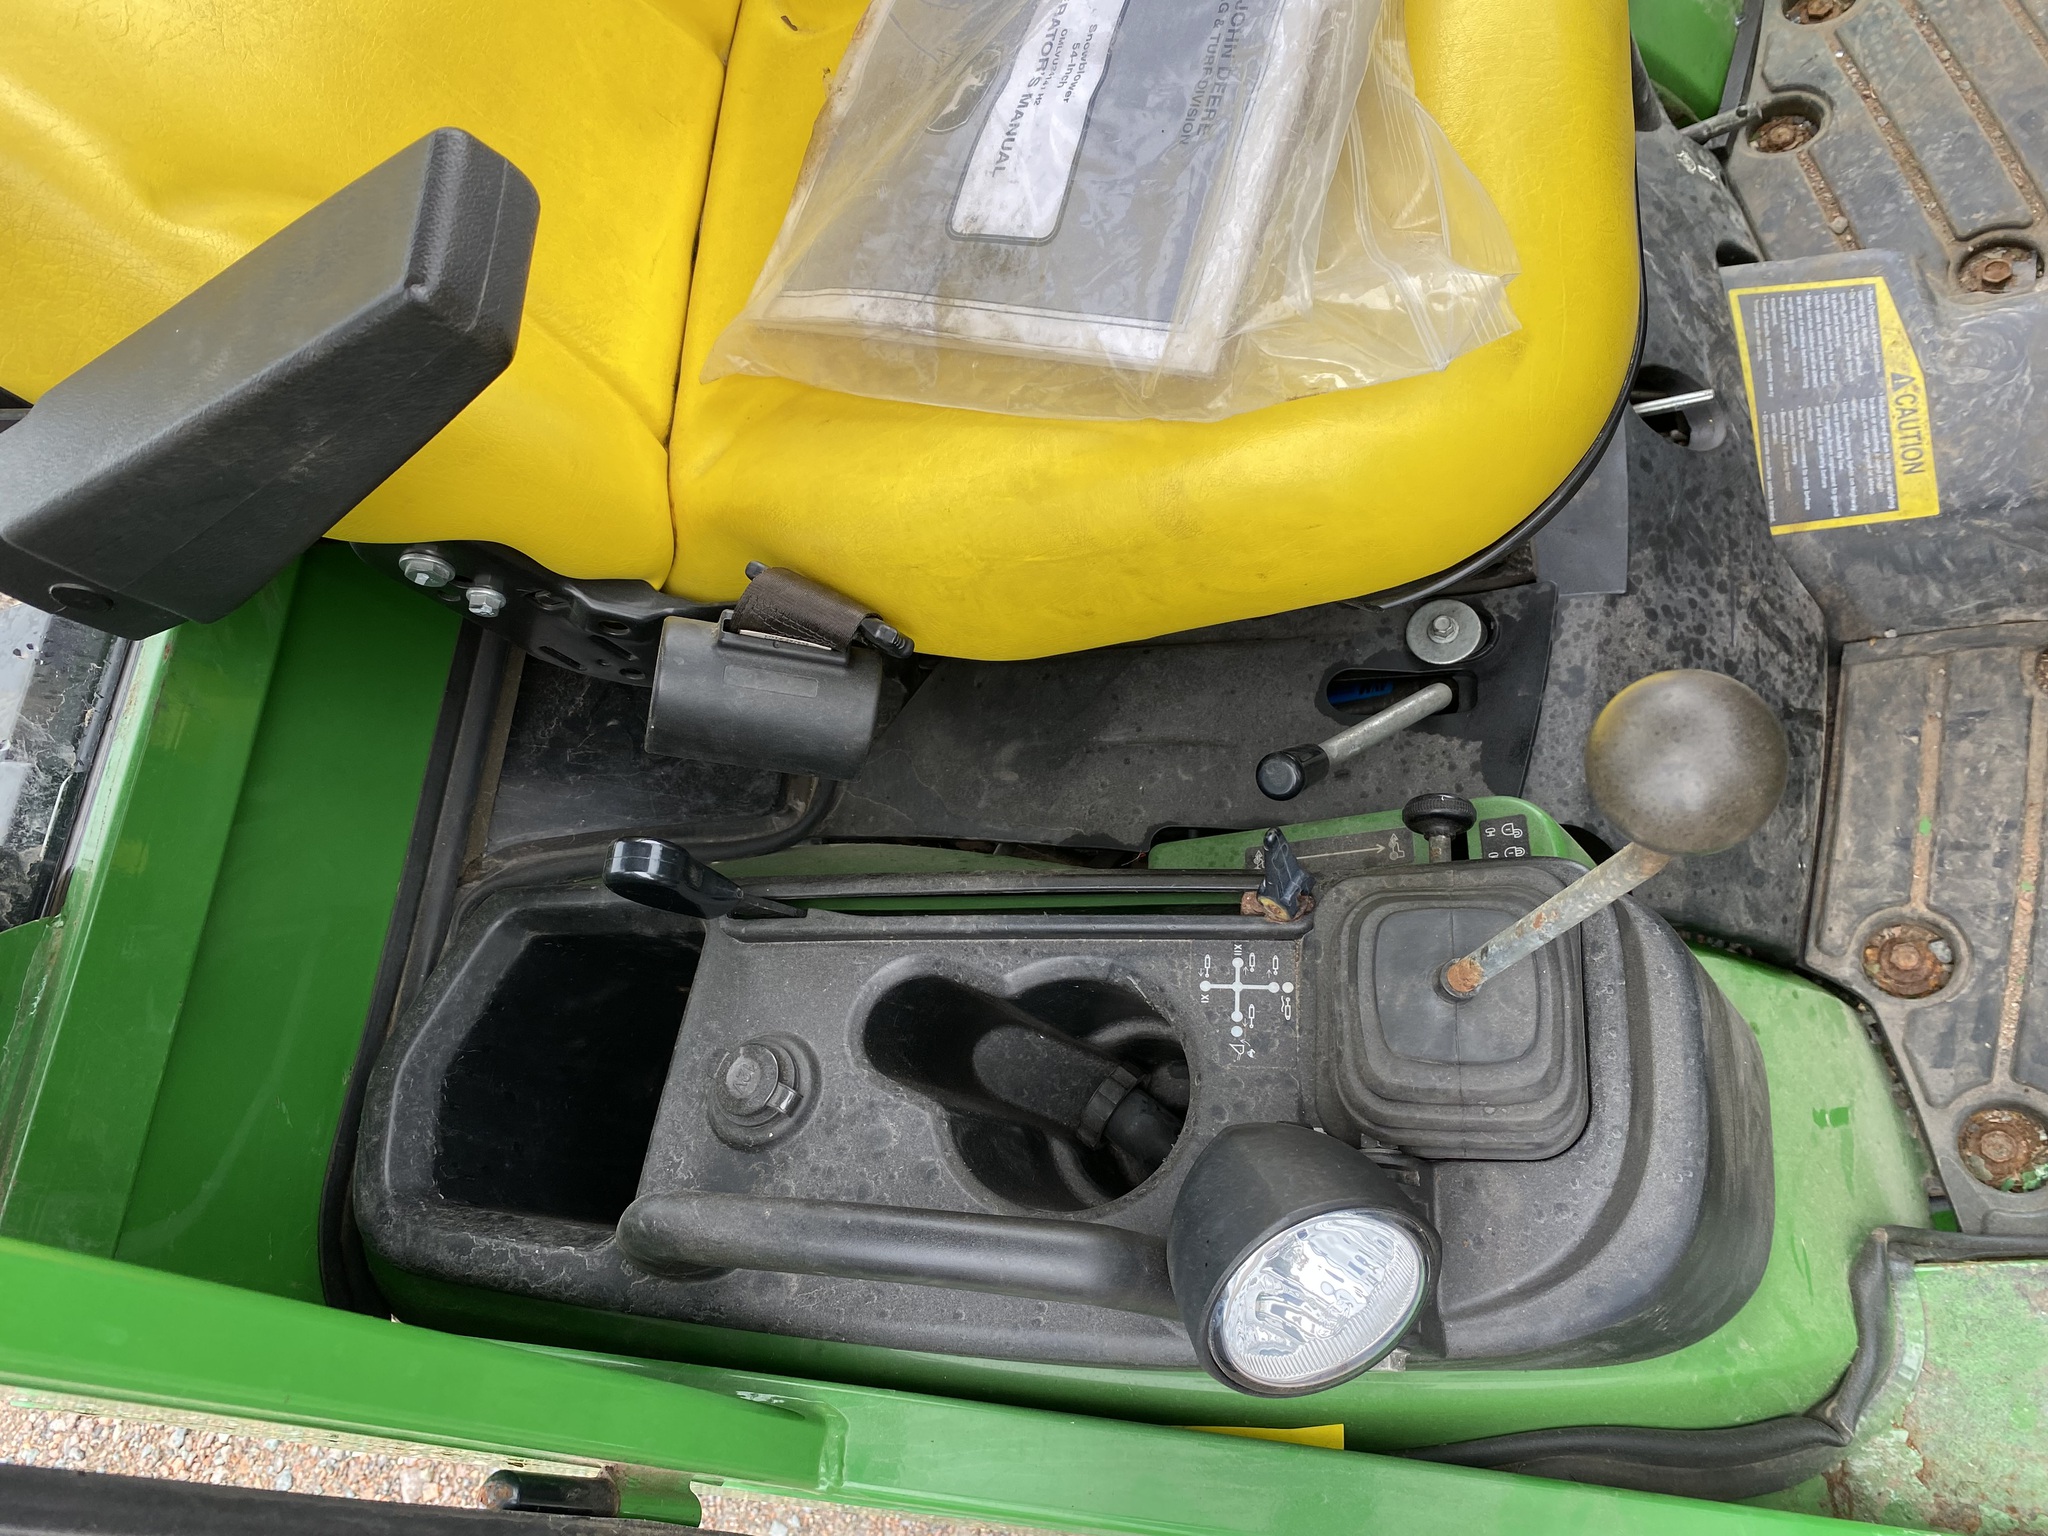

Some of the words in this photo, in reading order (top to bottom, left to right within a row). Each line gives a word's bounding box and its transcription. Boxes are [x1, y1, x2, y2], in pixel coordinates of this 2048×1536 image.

[1213, 18, 1224, 28] &
[1217, 0, 1229, 14] G
[1221, 0, 1248, 58] JOHN
[1028, 0, 1070, 88] RATOR'S
[1057, 42, 1080, 88] 54-Inch
[1063, 24, 1098, 103] Snowblower
[1203, 32, 1221, 76] TURF
[1179, 79, 1208, 145] DIVISION
[1197, 66, 1232, 136] DEERE
[992, 93, 1033, 178] MANUAL
[1895, 393, 1926, 475] CAUTION
